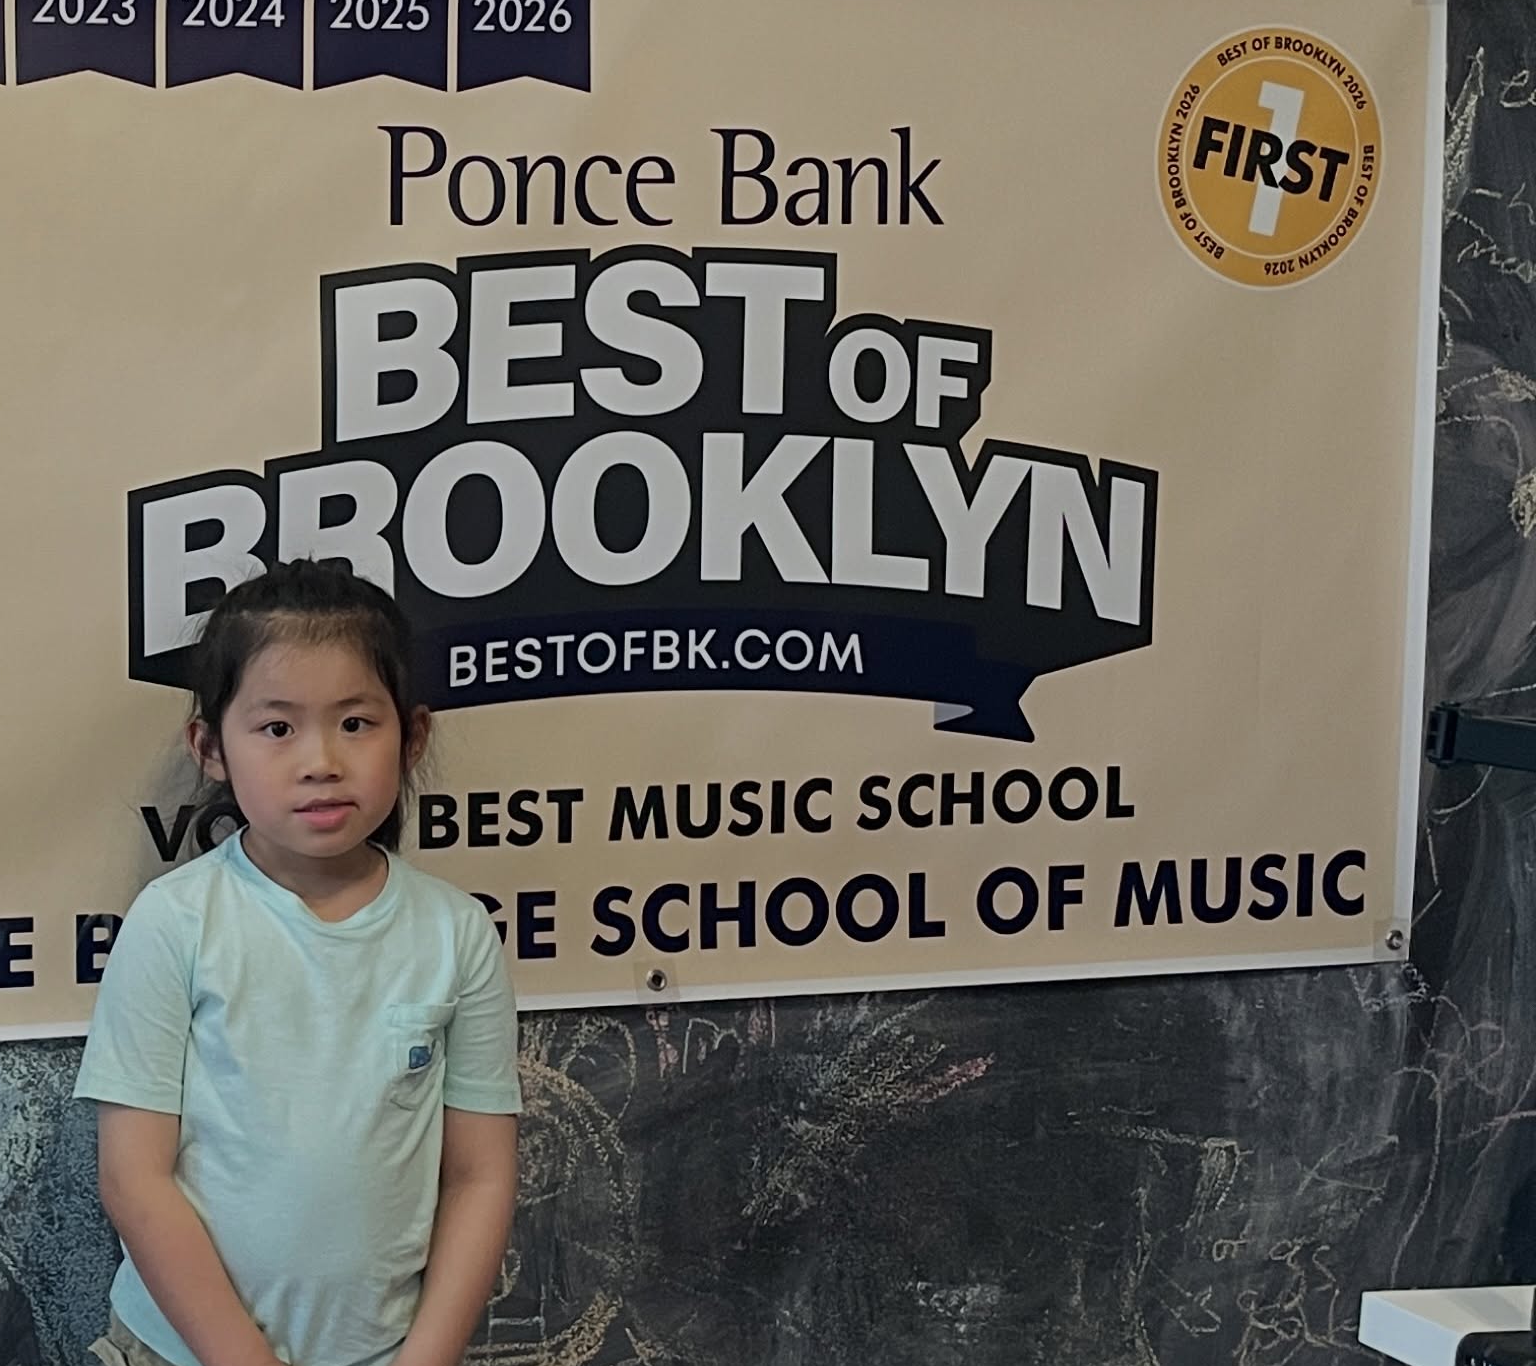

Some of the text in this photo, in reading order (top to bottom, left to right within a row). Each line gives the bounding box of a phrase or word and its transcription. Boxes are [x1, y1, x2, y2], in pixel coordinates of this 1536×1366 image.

[1216, 36, 1368, 110] BEST OF BROOKLYN 2026
[377, 124, 945, 228] Ponce Bank
[1167, 83, 1225, 260] BEST OF BROOKLYN 2026
[1192, 115, 1351, 203] FIRST
[1264, 144, 1375, 276] BEST OF BROOKLYN 2026
[335, 257, 980, 443] BEST OF
[143, 430, 1146, 658] BROOKLYN
[448, 628, 864, 689] BESTOFBK.COM
[418, 765, 1135, 850] BEST MUSIC SCHOOL
[590, 872, 947, 959] SCHOOL
[976, 863, 1086, 937] OF
[1114, 848, 1368, 929] MUSIC
